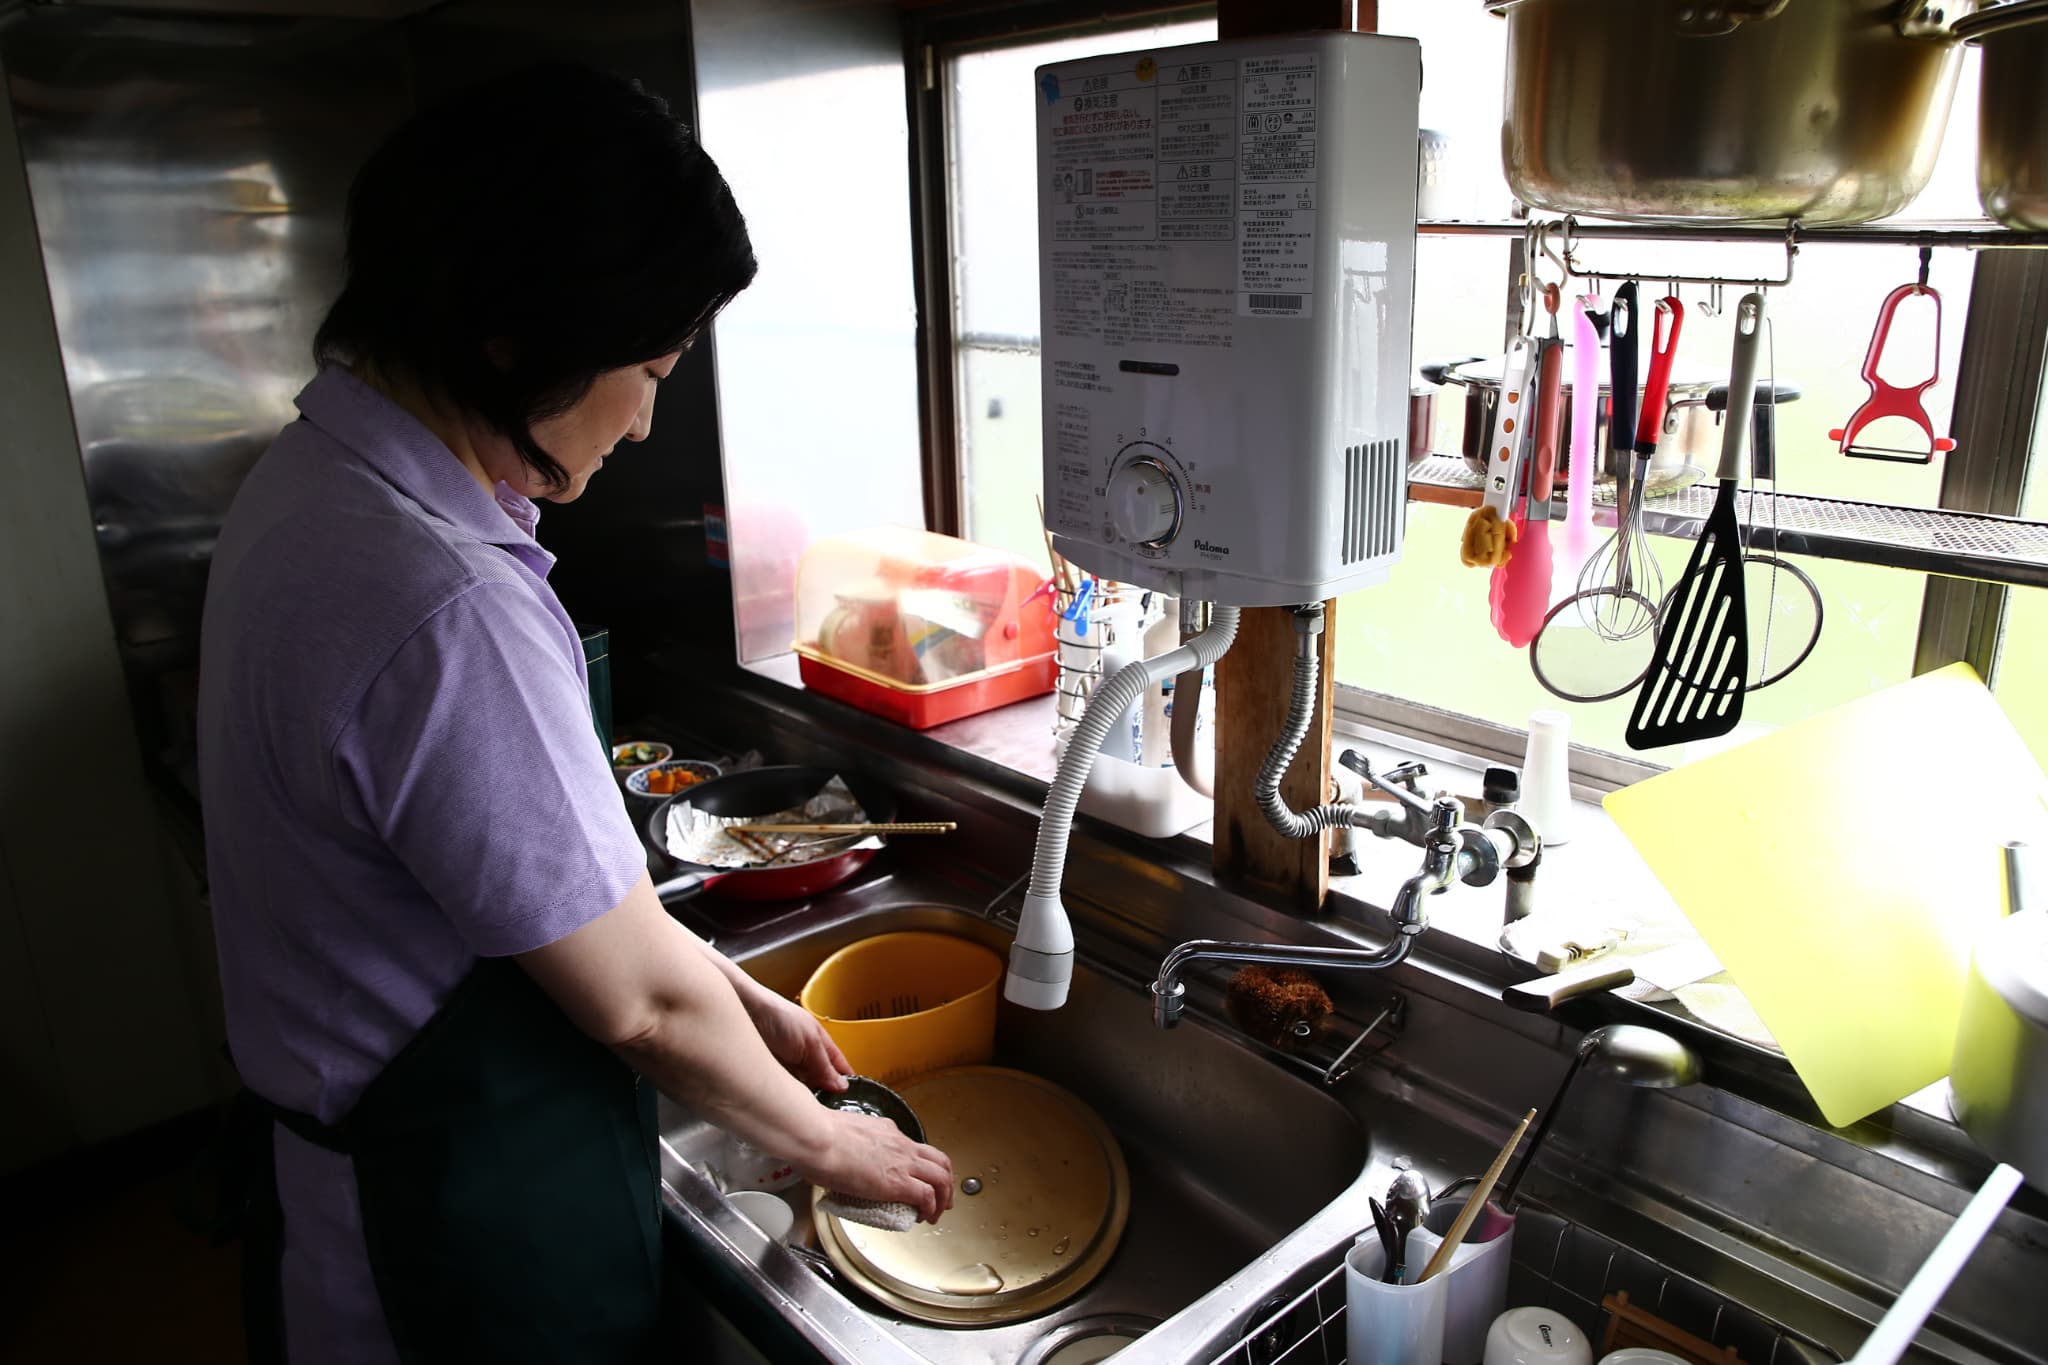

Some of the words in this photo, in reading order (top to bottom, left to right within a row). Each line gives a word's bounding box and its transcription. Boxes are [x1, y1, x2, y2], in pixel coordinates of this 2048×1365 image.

[1190, 165, 1212, 177] 注意
[1139, 427, 1147, 437] 3
[1116, 433, 1124, 443] 2
[1165, 436, 1173, 446] 4
[1194, 539, 1230, 555] Paloma
